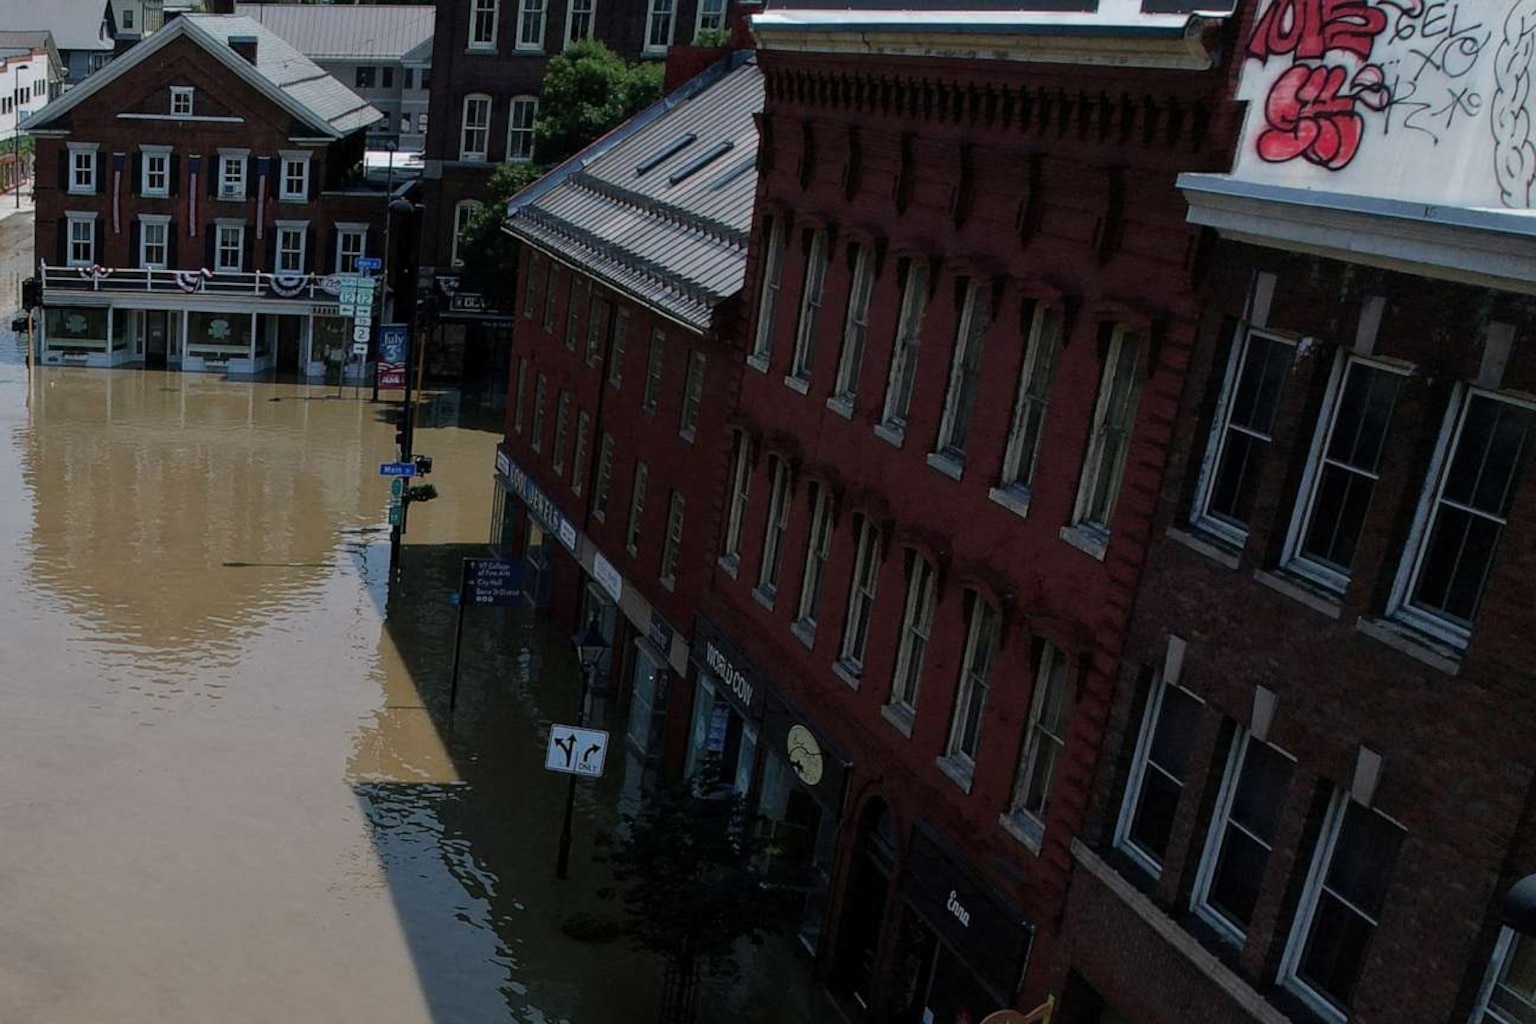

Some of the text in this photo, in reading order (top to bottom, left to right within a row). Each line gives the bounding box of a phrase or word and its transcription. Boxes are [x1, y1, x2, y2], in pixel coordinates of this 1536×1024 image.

[383, 332, 405, 348] July
[384, 466, 403, 475] Main
[706, 641, 734, 685] WORLD
[731, 671, 755, 707] COW
[578, 762, 597, 772] ONLY
[946, 890, 973, 928] Enna
